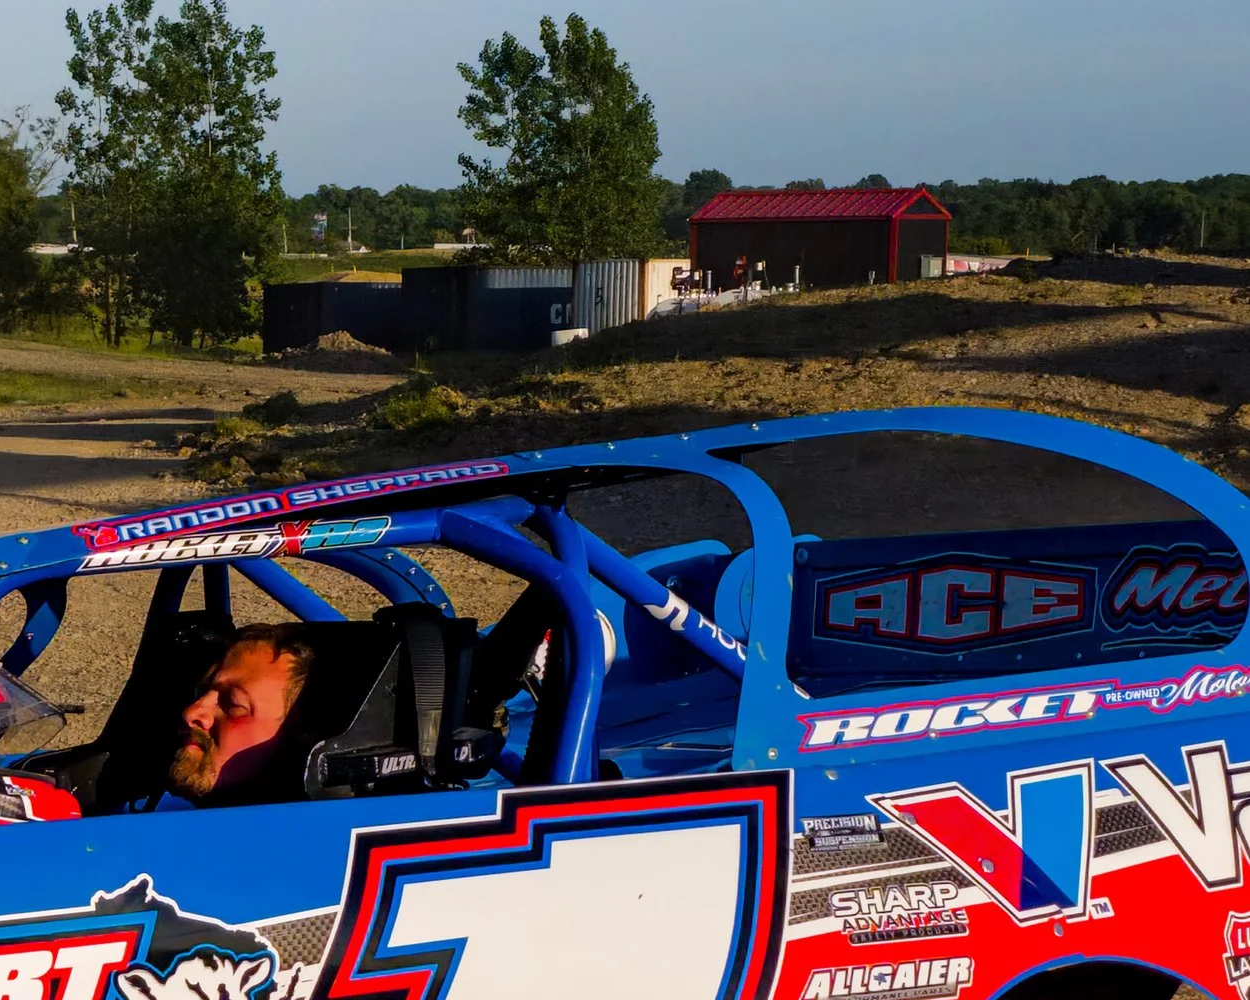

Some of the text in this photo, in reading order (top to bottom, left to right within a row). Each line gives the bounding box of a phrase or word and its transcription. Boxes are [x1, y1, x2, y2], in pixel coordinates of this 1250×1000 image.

[291, 462, 502, 505] SHEPPARD
[827, 568, 1079, 640] ACE
[1114, 565, 1247, 610] Met
[807, 685, 1112, 746] ROCKET
[1105, 687, 1160, 703] PRE-OWNED
[381, 754, 417, 774] ULTR
[803, 815, 877, 835] PRECISION
[814, 833, 880, 847] SUSPENSION
[830, 882, 958, 917] SHARP
[842, 909, 968, 932] ADVANTAGE
